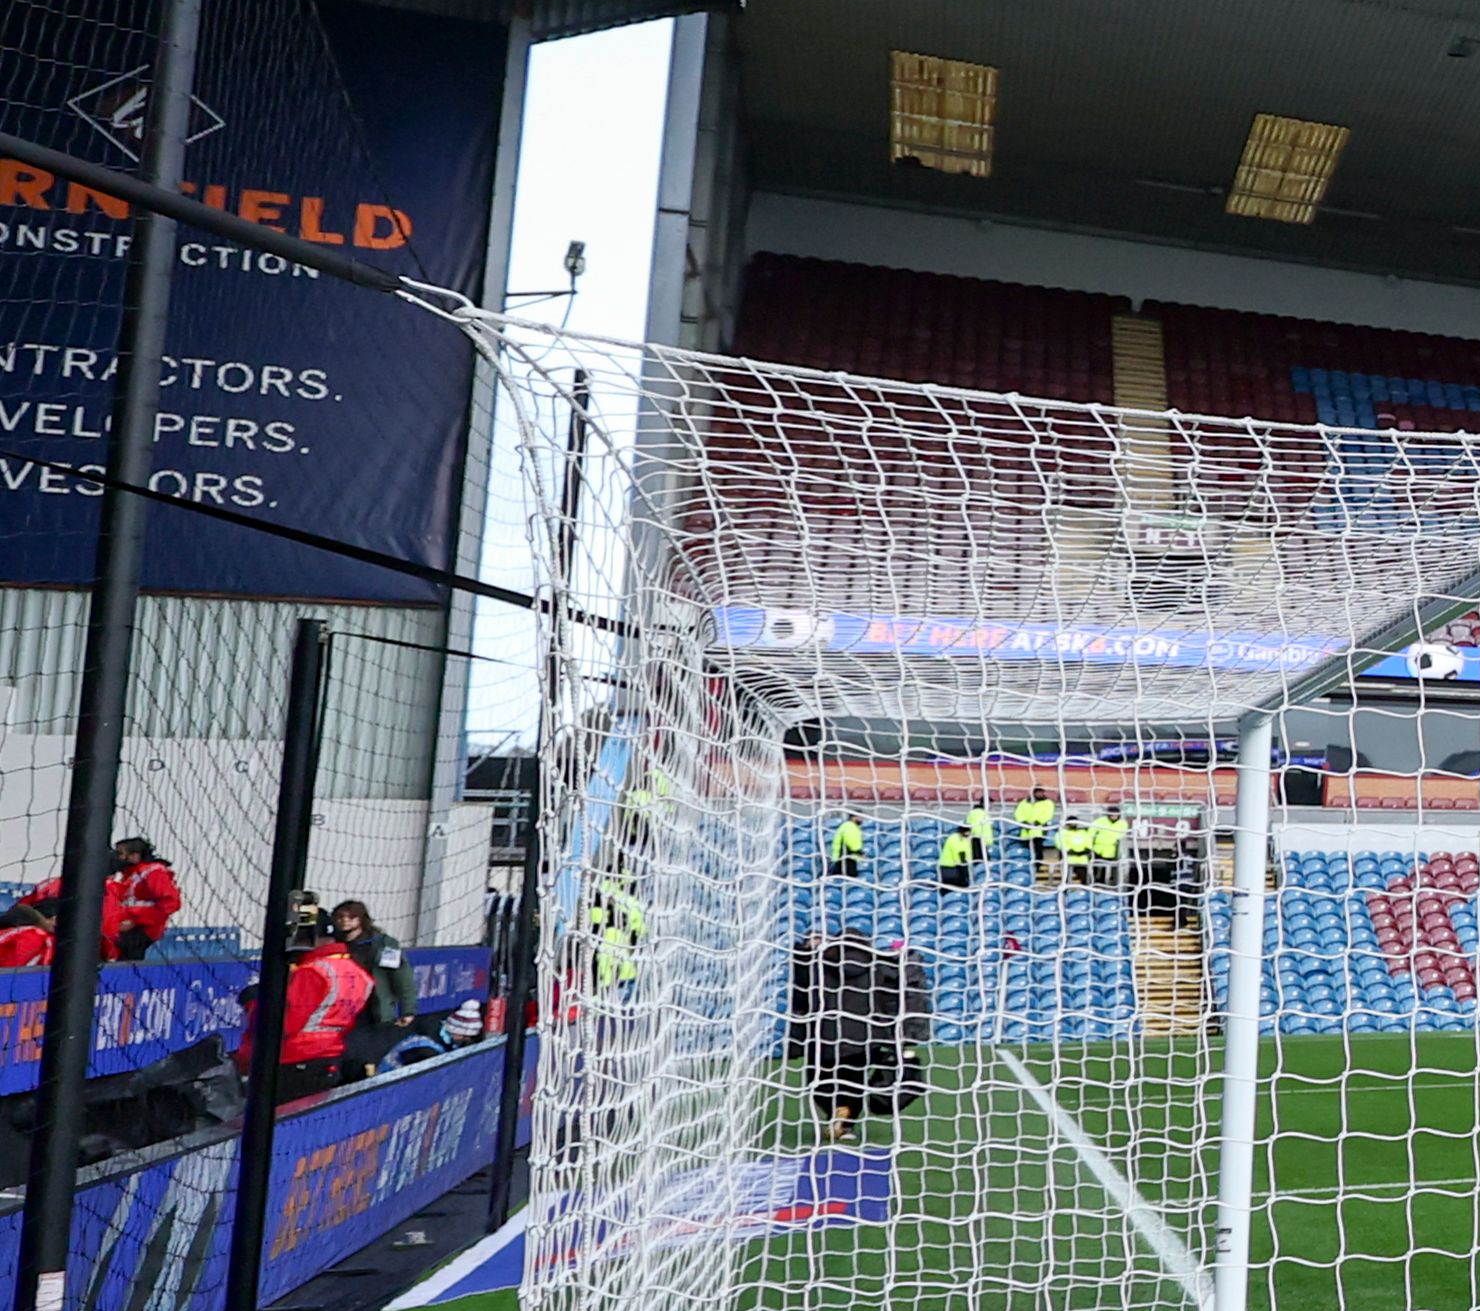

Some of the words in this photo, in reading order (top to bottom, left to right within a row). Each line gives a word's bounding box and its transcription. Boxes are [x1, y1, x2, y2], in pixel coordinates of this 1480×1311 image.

[0, 158, 412, 250] RNIELD
[0, 224, 320, 279] NSTRCTION
[0, 400, 311, 455] VELPERS.
[0, 458, 278, 509] VESORS.
